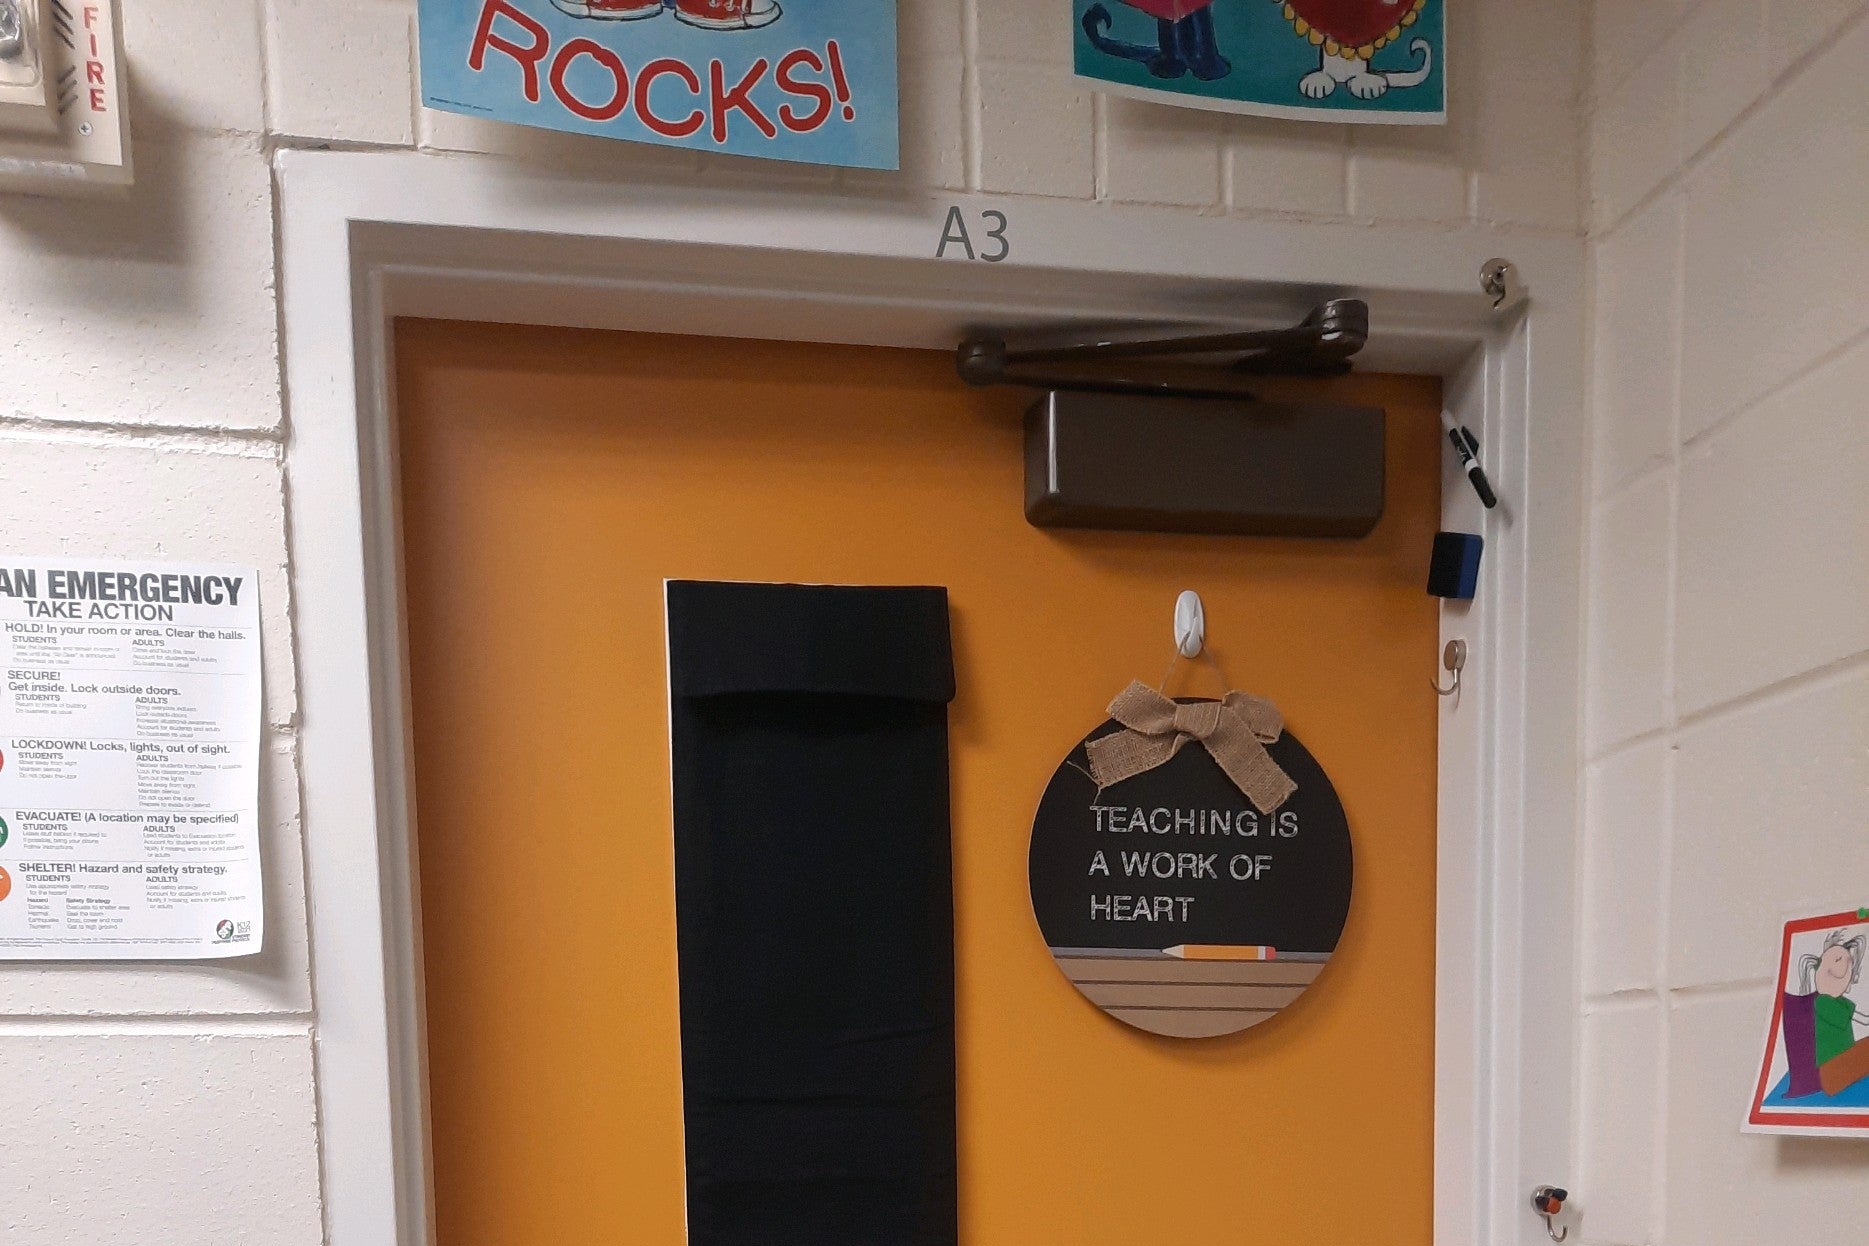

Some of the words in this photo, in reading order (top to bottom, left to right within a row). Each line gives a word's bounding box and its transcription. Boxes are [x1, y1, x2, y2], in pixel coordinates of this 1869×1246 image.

[83, 6, 107, 112] FIRE
[467, 0, 856, 143] ROCKS!
[935, 205, 1010, 262] A3
[0, 568, 37, 598] AN
[47, 569, 243, 606] EMERGENCY
[24, 600, 82, 618] TAKE
[88, 602, 174, 621] ACTION
[5, 622, 44, 633] HOLD!
[46, 624, 57, 634] In
[60, 626, 85, 636] your
[88, 627, 118, 635] room
[135, 628, 162, 637] area.
[165, 627, 195, 638] Clear
[198, 629, 216, 639] the
[218, 630, 246, 640] halls.
[12, 636, 57, 644] STUDENTS
[132, 639, 165, 647] ADULTS
[8, 670, 61, 680] SECURE!
[8, 681, 29, 691] Get
[31, 682, 67, 692] inside.
[71, 683, 99, 693] Lock
[101, 684, 143, 694] outside
[146, 685, 182, 696] doors.
[15, 693, 60, 701] STUDENTS
[11, 739, 87, 750] LOCKDOWN!
[90, 741, 127, 752] Locks,
[130, 741, 164, 753] lights,
[166, 744, 184, 753] out
[187, 744, 199, 753] of
[201, 745, 230, 756] sight.
[18, 752, 64, 760] STUDENTS
[15, 811, 82, 822] EVACUATE!
[85, 812, 96, 823] (A
[99, 812, 144, 822] location
[147, 815, 170, 824] may
[173, 813, 187, 823] be
[190, 813, 239, 825] specified)
[1089, 804, 1258, 838] TEACHING
[1270, 810, 1298, 838] IS
[23, 823, 68, 831] STUDENTS
[143, 825, 176, 833] ADULTS
[19, 863, 75, 872] SHELTER!
[79, 863, 118, 873] Hazard
[122, 864, 142, 873] and
[146, 865, 179, 875] safety
[182, 865, 228, 876] strategy.
[1087, 850, 1110, 877] A
[1120, 851, 1218, 880] WORK
[1229, 853, 1273, 882] OF
[26, 874, 71, 882] STUDENTS
[1090, 894, 1195, 923] HEART
